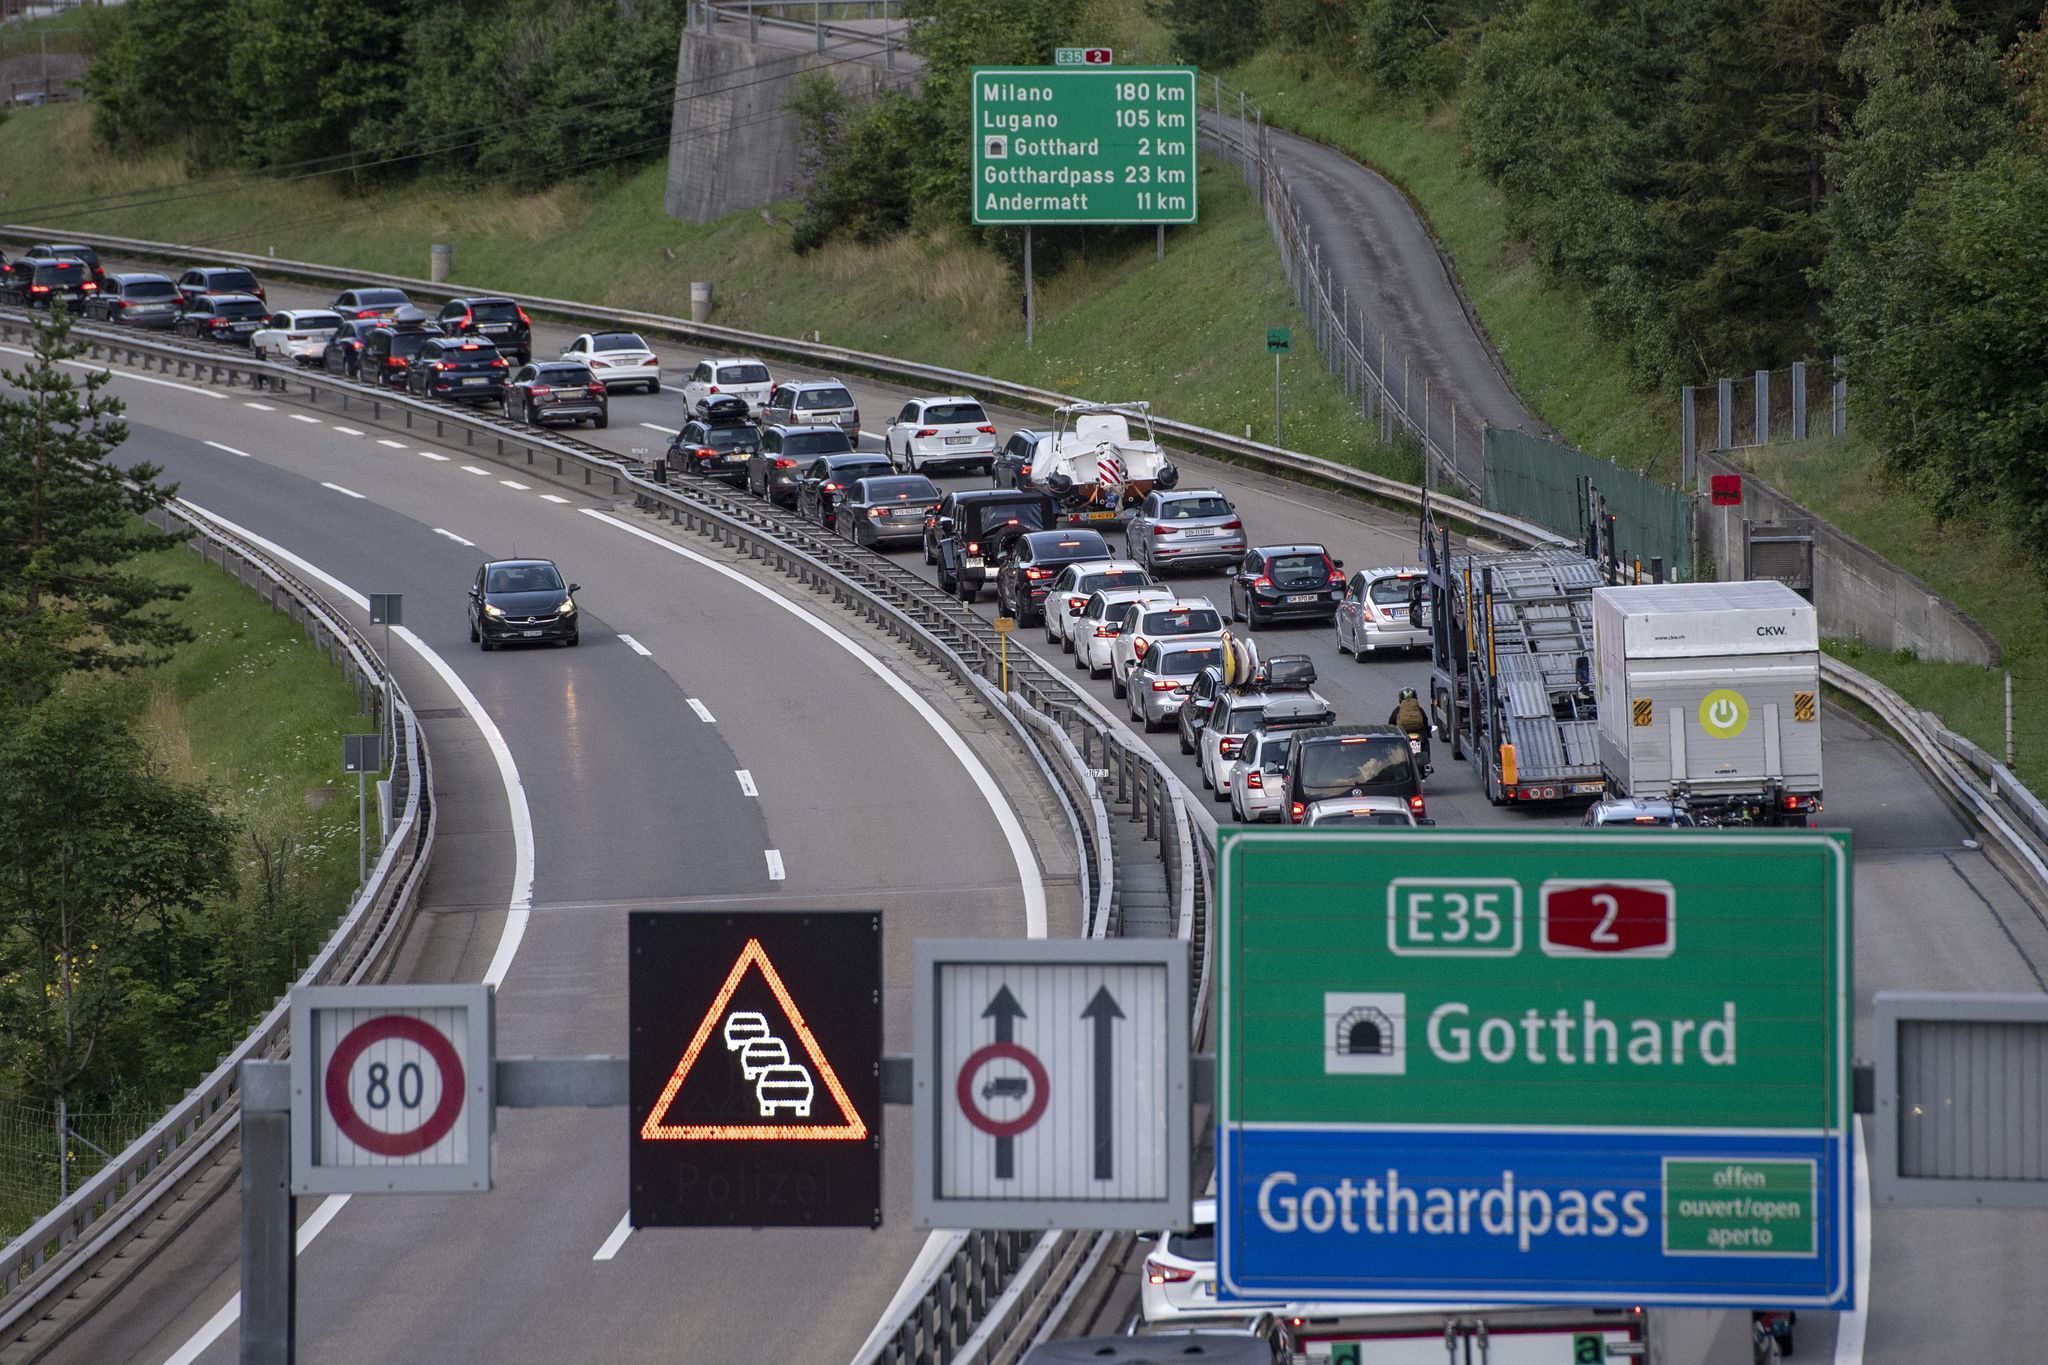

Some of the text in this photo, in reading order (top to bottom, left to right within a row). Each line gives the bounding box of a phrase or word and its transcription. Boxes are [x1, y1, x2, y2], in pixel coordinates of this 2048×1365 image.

[1059, 51, 1082, 62] E35
[1094, 51, 1102, 63] 2
[984, 83, 1185, 101] Milano 180 km
[984, 110, 1185, 132] Lugano 105 km
[1015, 138, 1185, 156] Gotthard 2 km
[984, 166, 1185, 188] Gotthardpass 23 km
[985, 192, 1186, 210] Andermatt 11 km
[1407, 892, 1502, 944] E35
[1590, 893, 1621, 945] 2
[1426, 1000, 1737, 1067] Gotthard
[367, 1061, 424, 1110] 80
[677, 1163, 832, 1205] Polizei
[1713, 1168, 1766, 1188] offen
[1257, 1168, 1650, 1252] Gotthardpass
[1679, 1197, 1801, 1222] ouvert/open
[1707, 1226, 1773, 1248] aperto
[1578, 1336, 1600, 1363] a
